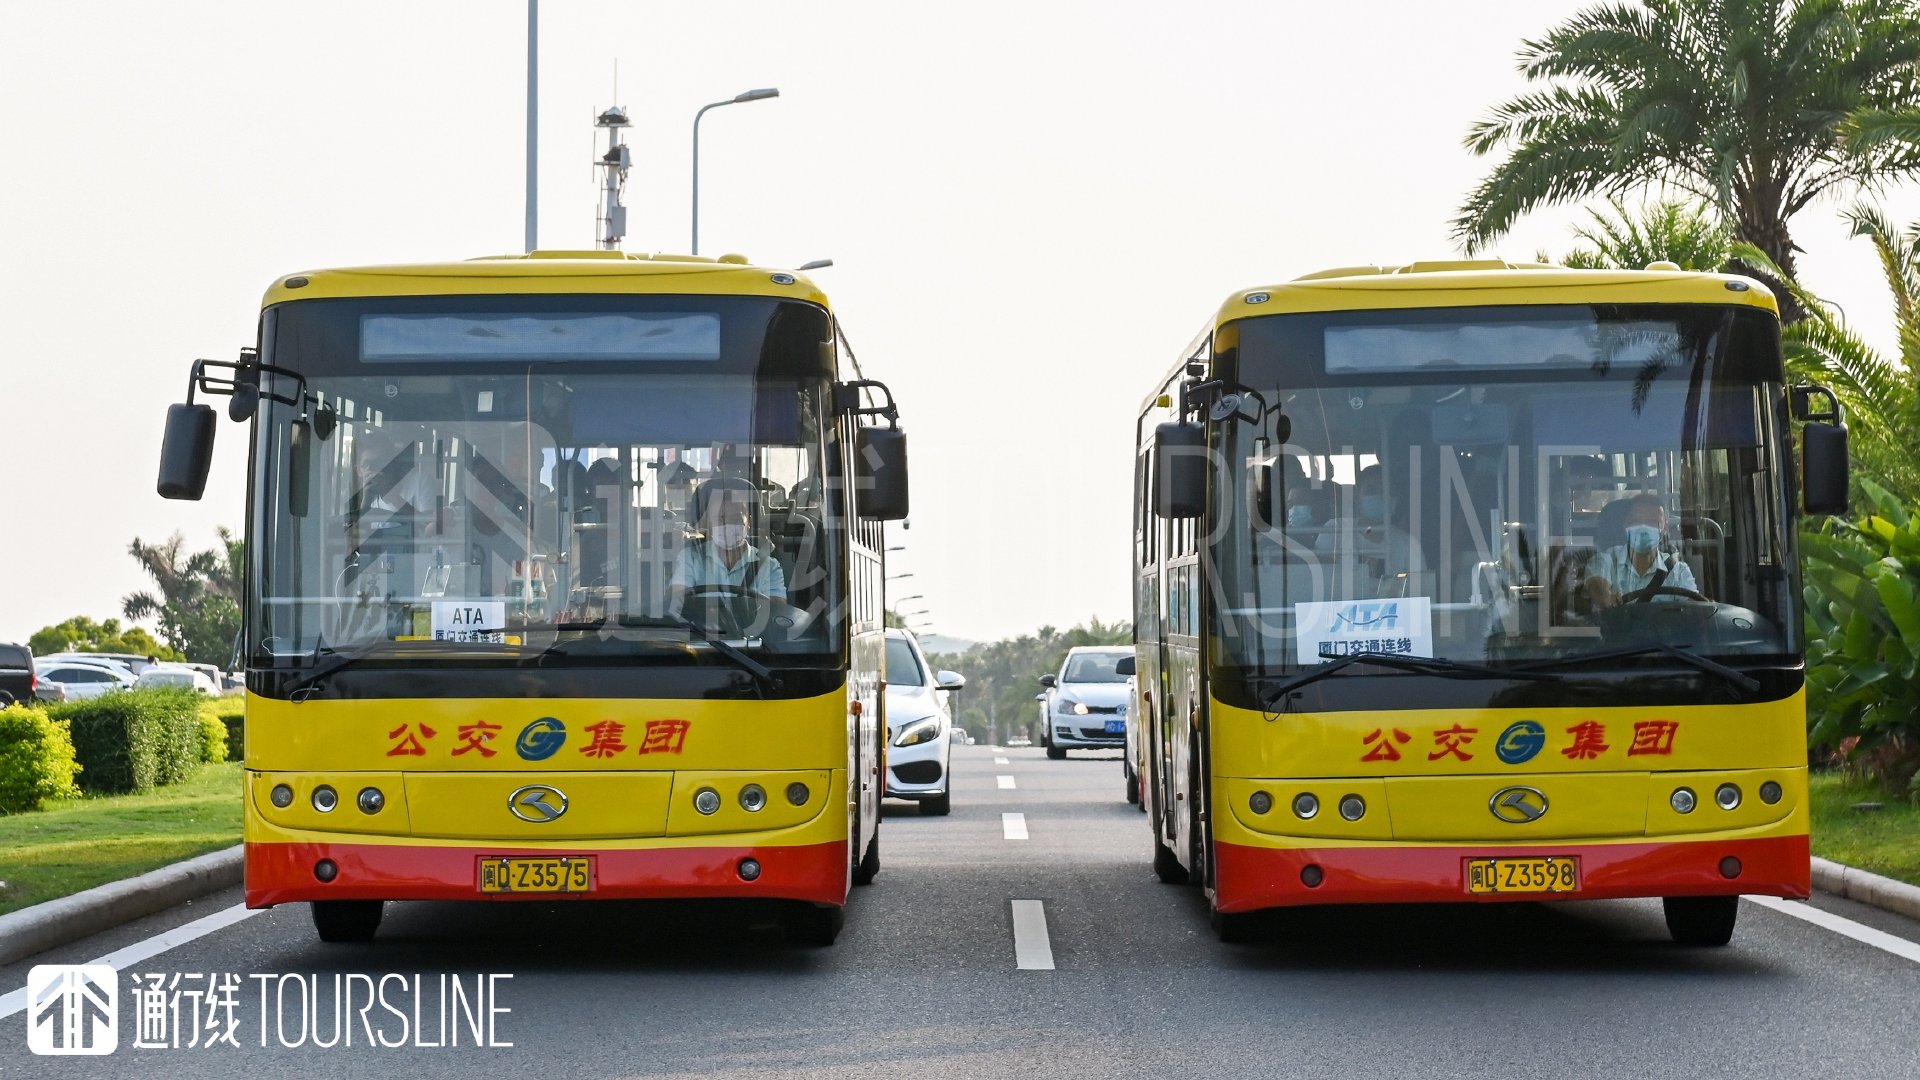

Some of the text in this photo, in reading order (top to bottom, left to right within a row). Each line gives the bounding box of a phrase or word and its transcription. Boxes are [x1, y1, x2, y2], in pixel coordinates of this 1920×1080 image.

[452, 607, 484, 625] ATA
[1329, 603, 1398, 632] ATA
[1318, 637, 1412, 656] 厦门交通连线
